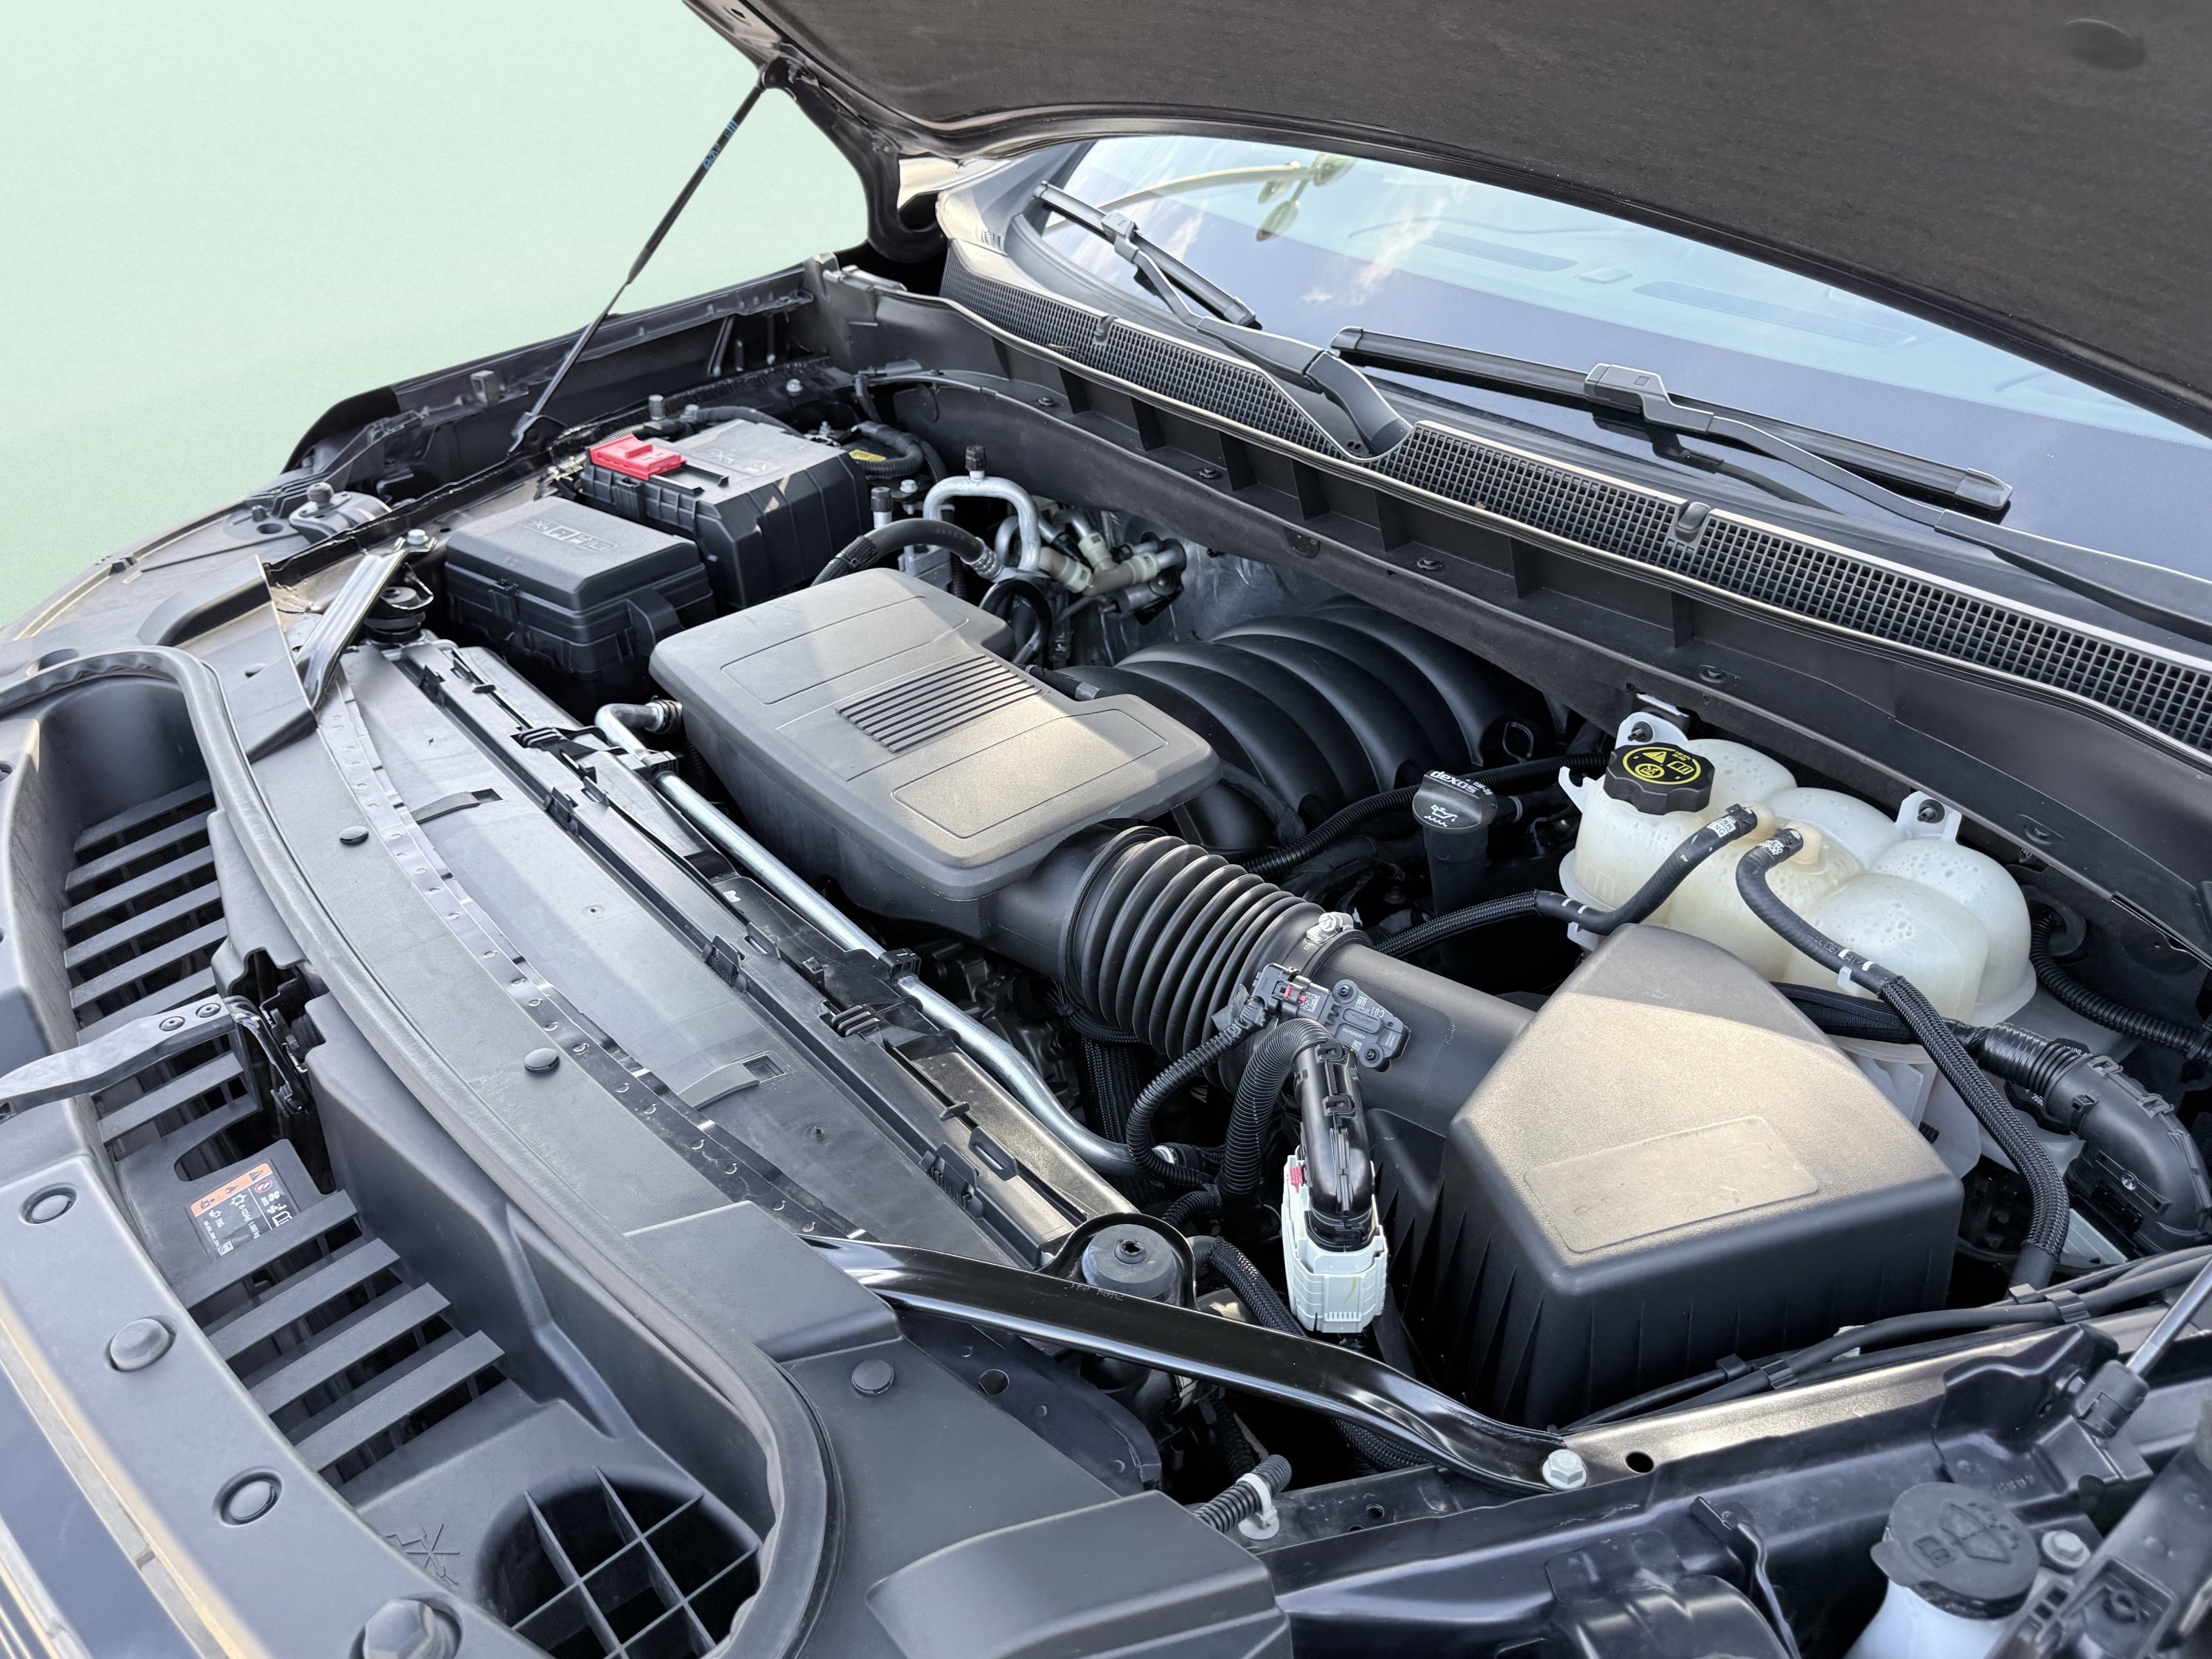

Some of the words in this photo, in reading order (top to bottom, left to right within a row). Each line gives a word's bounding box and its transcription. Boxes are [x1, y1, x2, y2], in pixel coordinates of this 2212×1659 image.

[1430, 771, 1480, 794] dexos
[1356, 997, 1366, 1006] GM
[1371, 1006, 1385, 1018] C01
[215, 1217, 225, 1228] PAG
